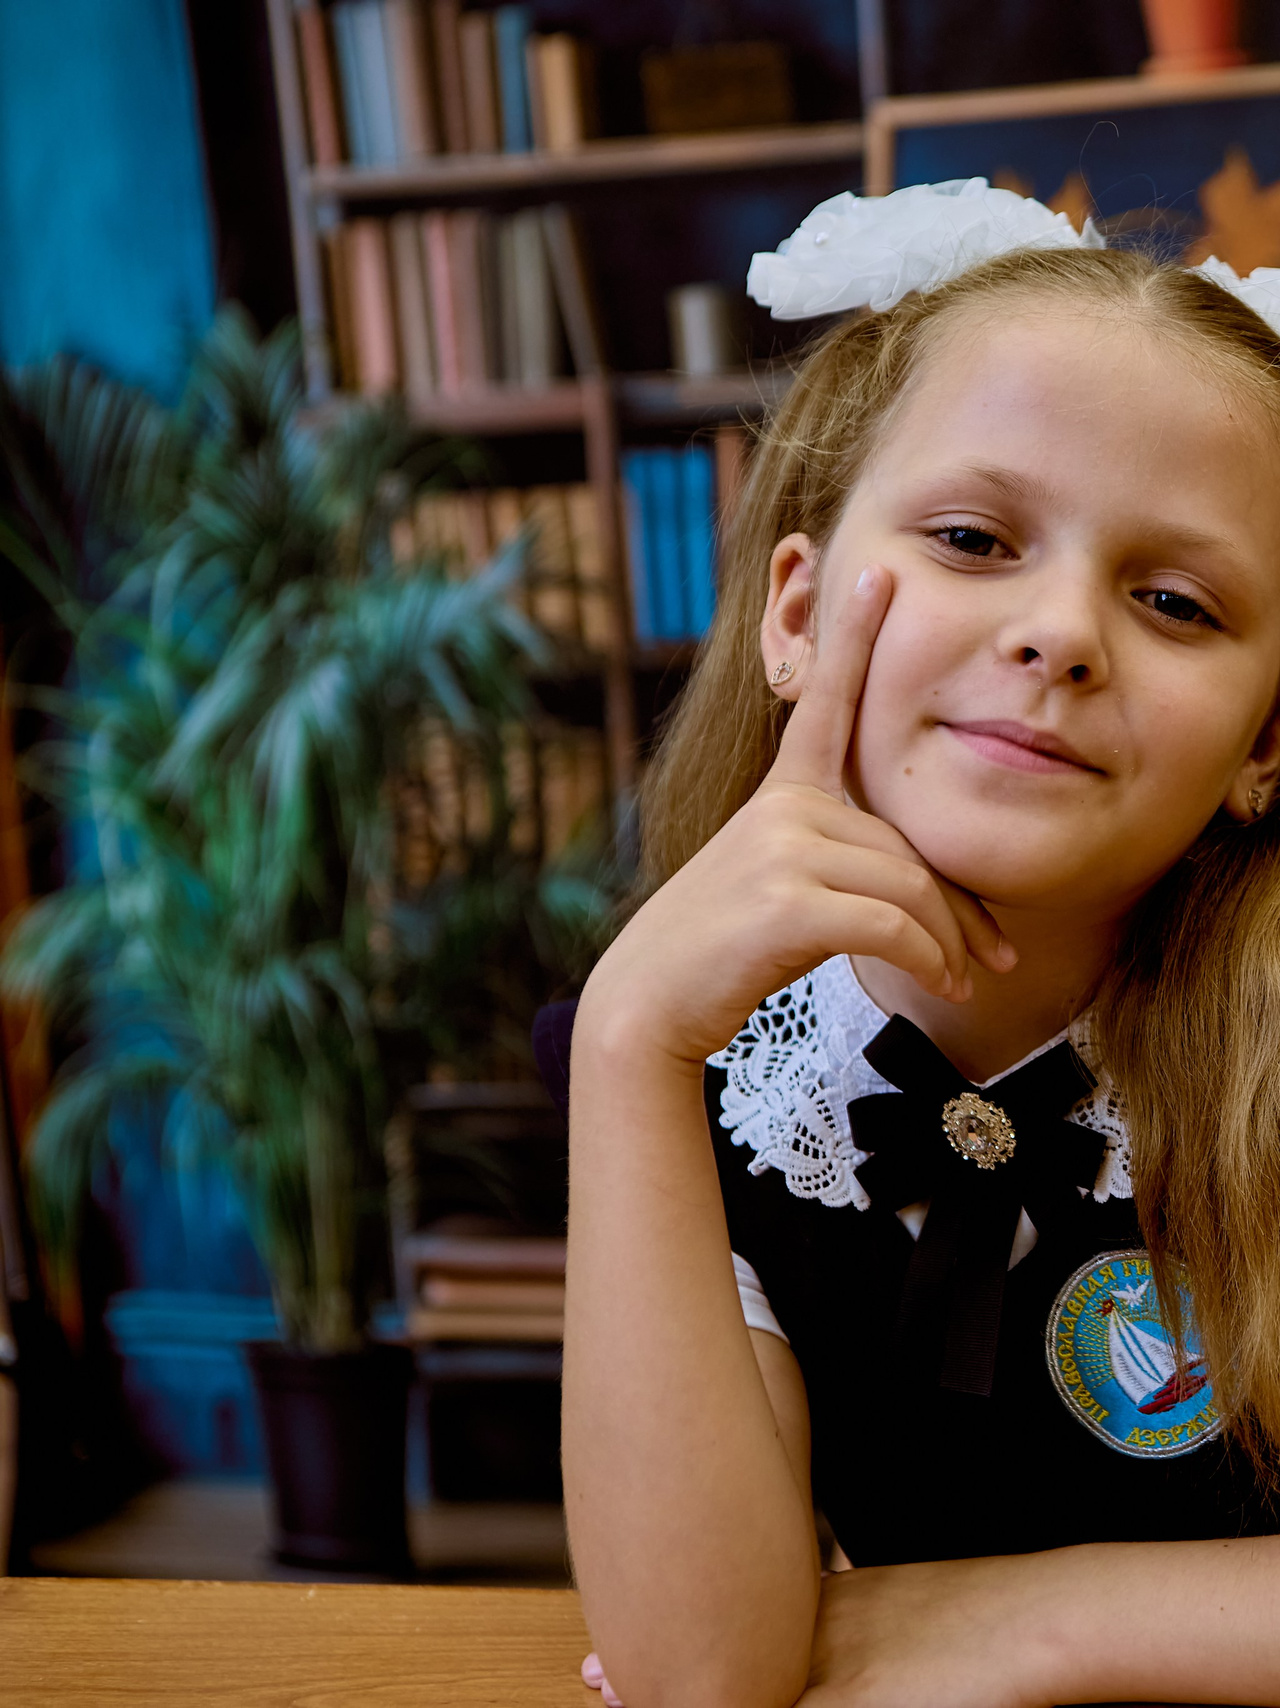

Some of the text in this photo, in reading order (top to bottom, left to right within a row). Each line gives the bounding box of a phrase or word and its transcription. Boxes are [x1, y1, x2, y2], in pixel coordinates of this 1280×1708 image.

[1057, 1259, 1152, 1423] ПРАВОСЛАВНАЯ ГИ
[1125, 1404, 1219, 1447] ДЗЕРЖИ
